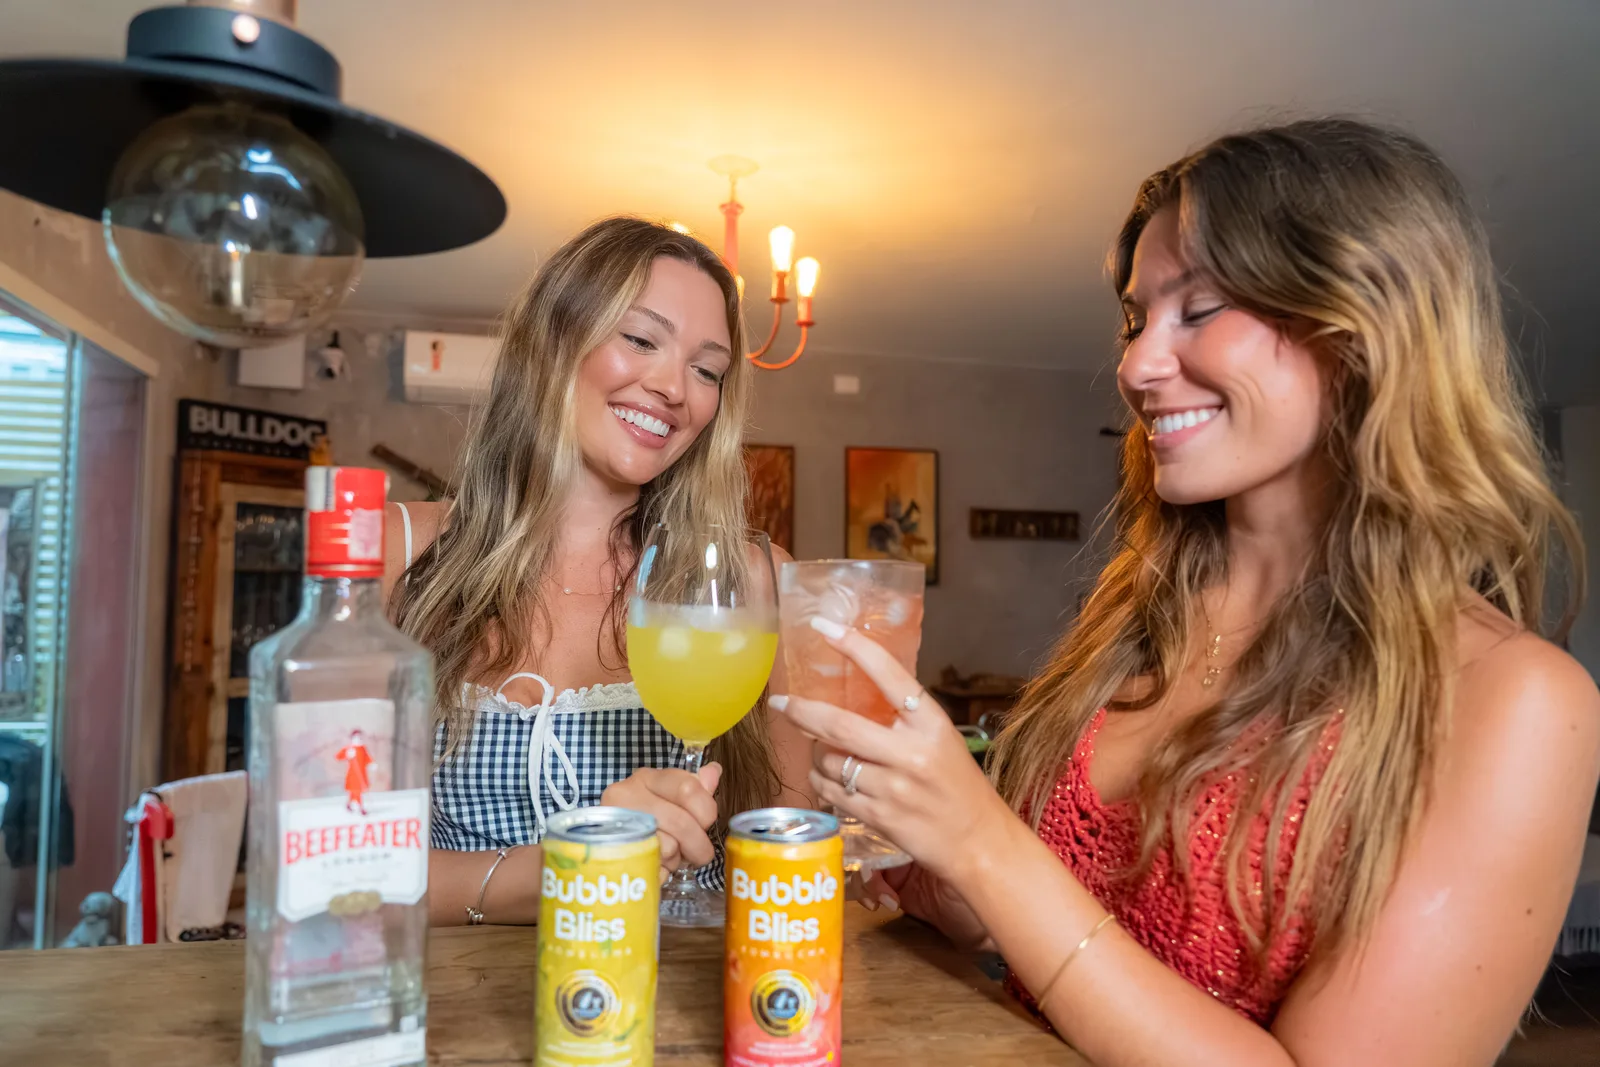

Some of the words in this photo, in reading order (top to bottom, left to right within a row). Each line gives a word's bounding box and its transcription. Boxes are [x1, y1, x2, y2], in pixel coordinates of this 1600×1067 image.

[285, 817, 422, 865] BEEFEATER
[541, 867, 647, 906] Bubble
[731, 868, 838, 906] Bubble
[554, 908, 626, 942] Bliss
[748, 909, 820, 942] Bliss
